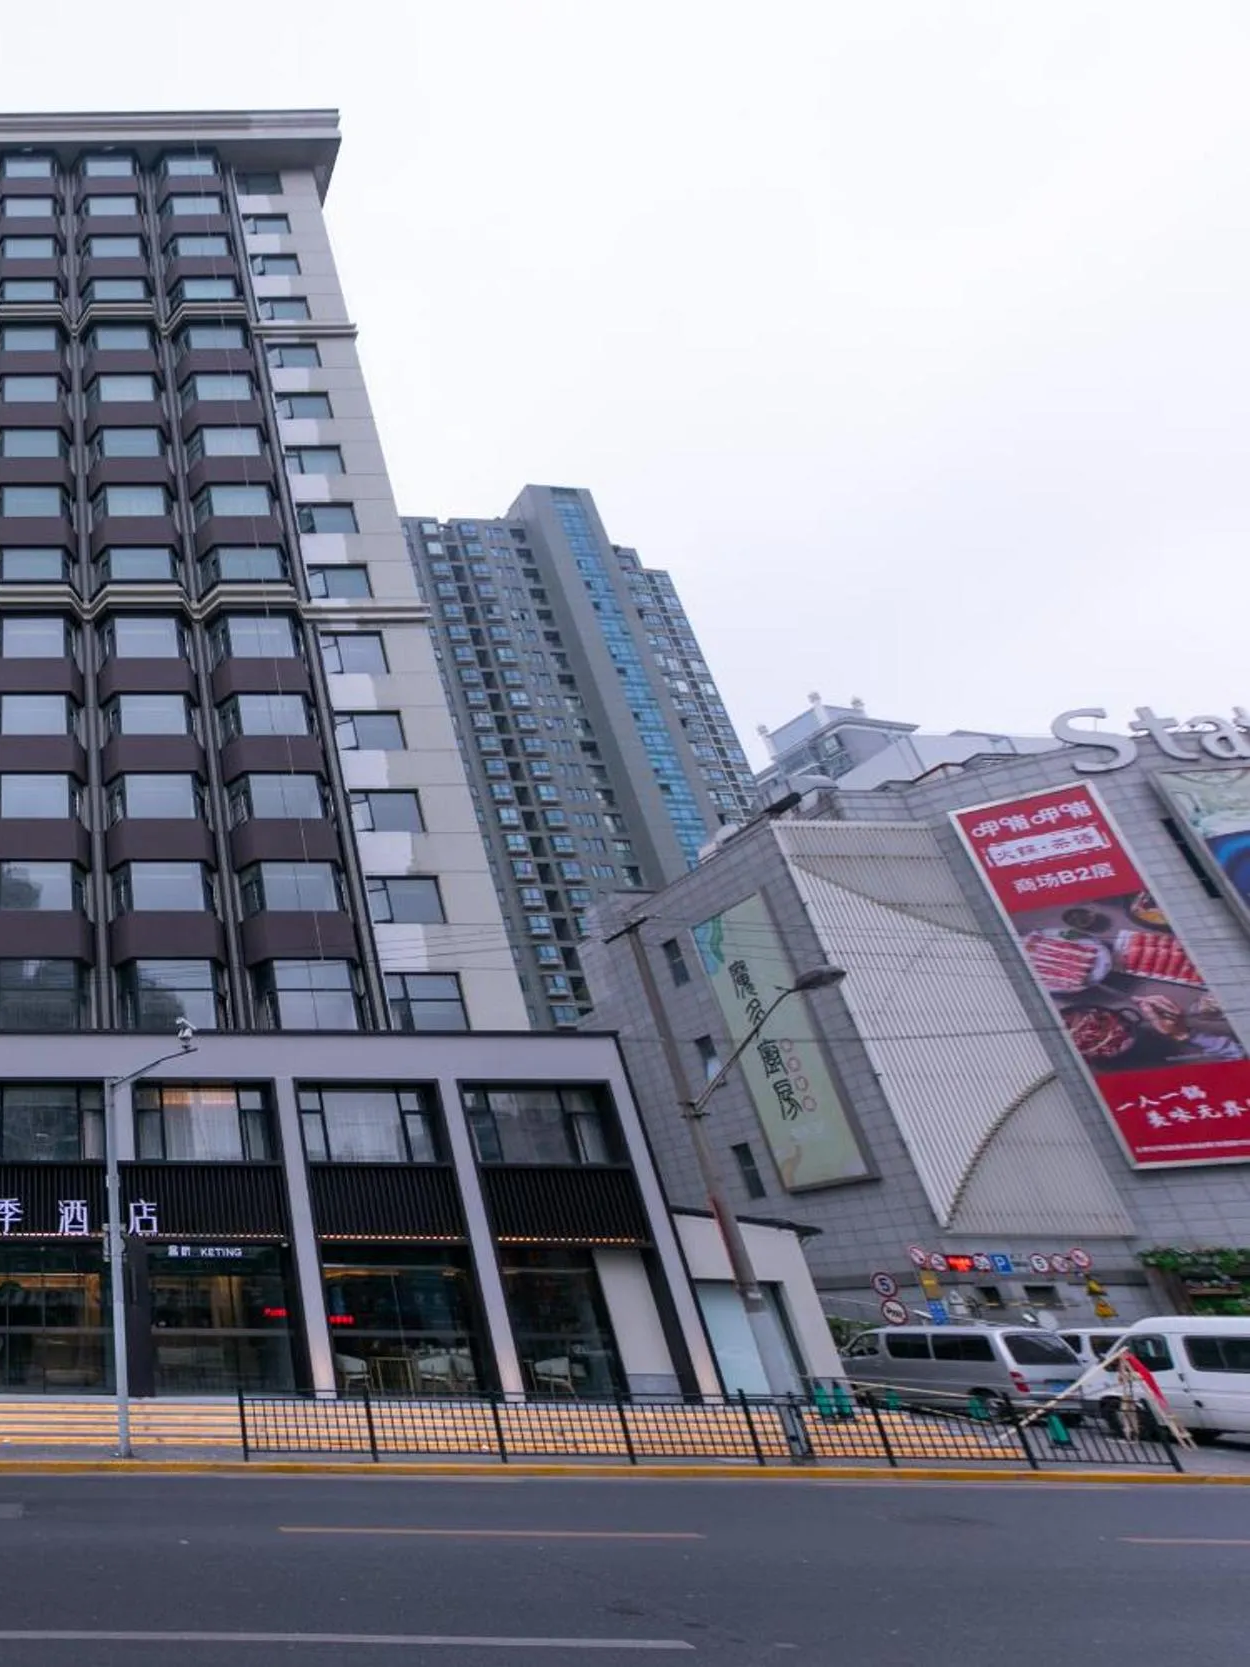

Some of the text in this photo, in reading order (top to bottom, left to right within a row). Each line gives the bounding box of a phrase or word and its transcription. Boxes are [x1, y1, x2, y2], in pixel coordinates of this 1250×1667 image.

[1051, 706, 1250, 775] Sta
[971, 799, 1094, 838] 呷哺呷哺
[1012, 861, 1117, 894] 商场B2层
[199, 1247, 243, 1258] KETING
